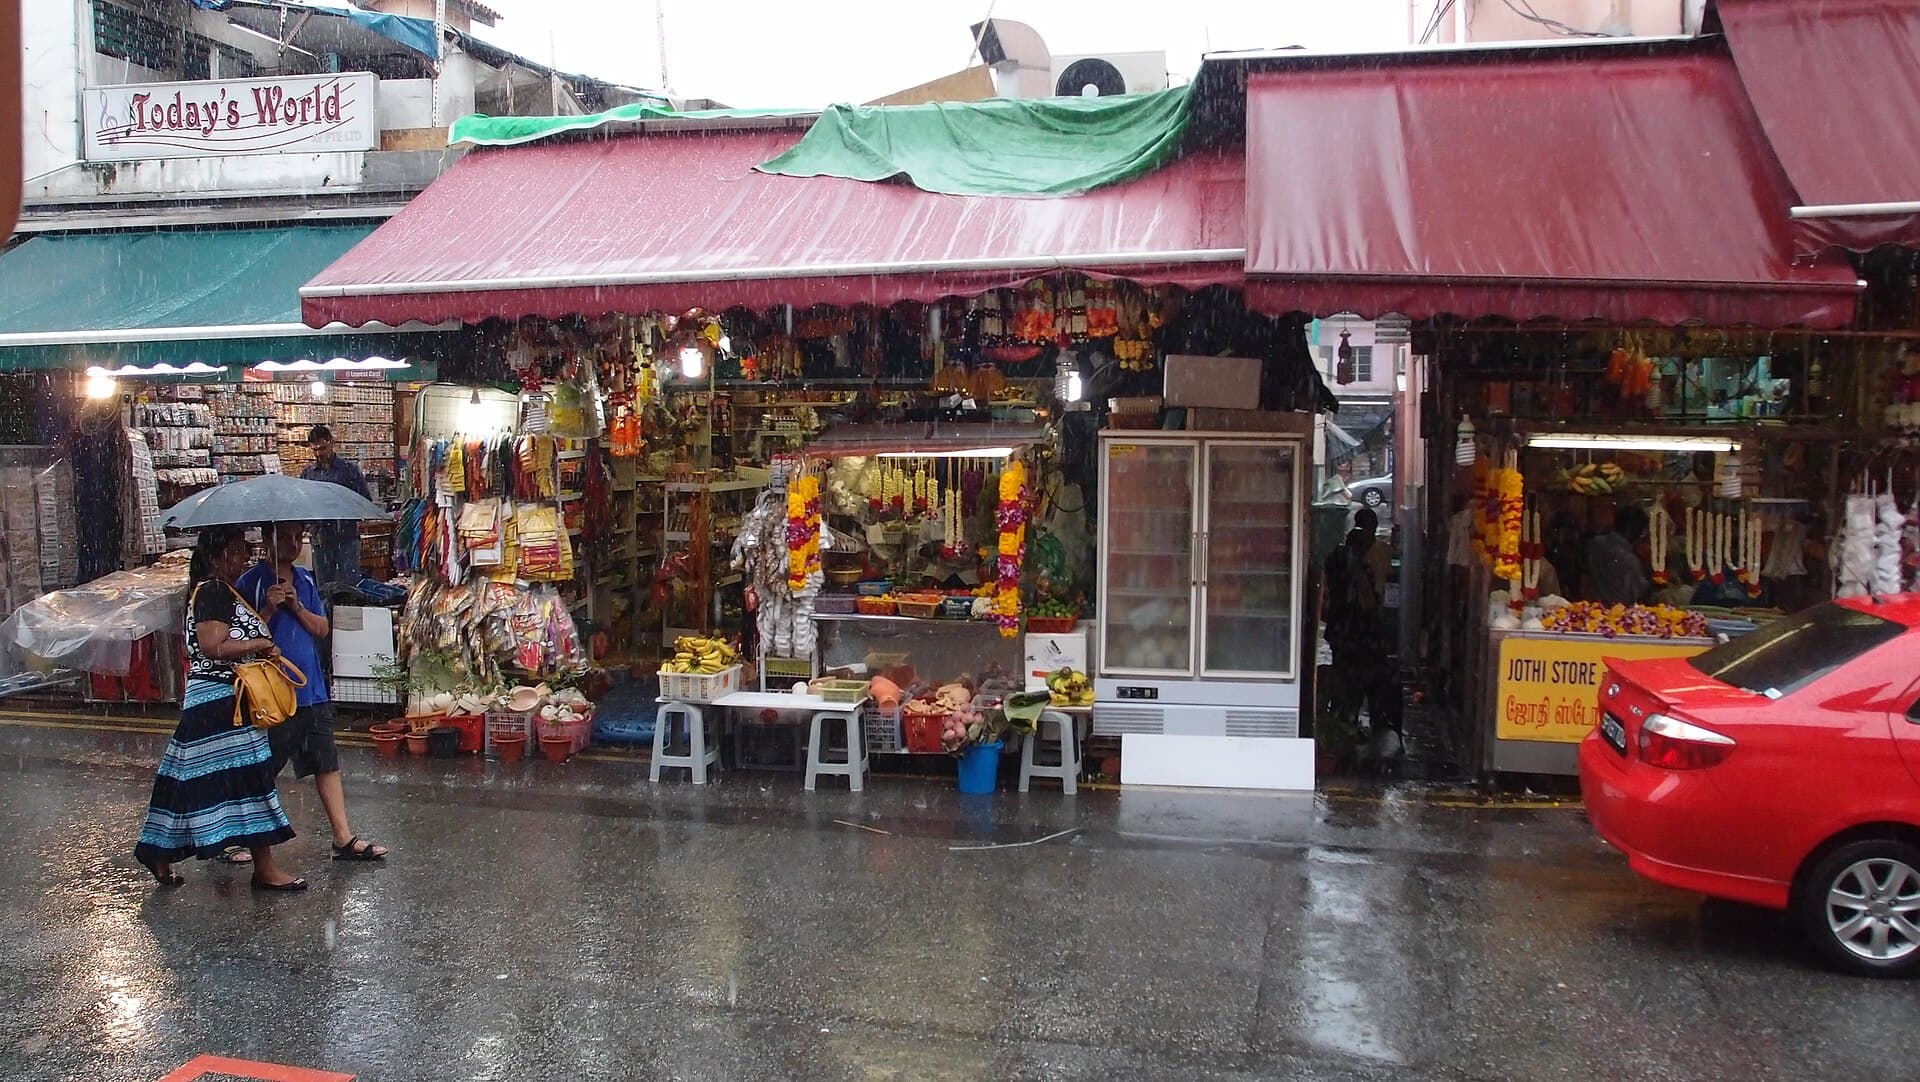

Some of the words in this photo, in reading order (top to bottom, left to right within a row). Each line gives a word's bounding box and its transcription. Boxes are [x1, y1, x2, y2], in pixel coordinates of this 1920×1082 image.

[131, 88, 240, 136] Today's
[251, 82, 341, 125] World
[1508, 658, 1546, 683] JOTHI
[1551, 660, 1597, 685] STORE
[1506, 694, 1550, 730] ஜோதி
[1555, 696, 1600, 726] ஸ்டோ
